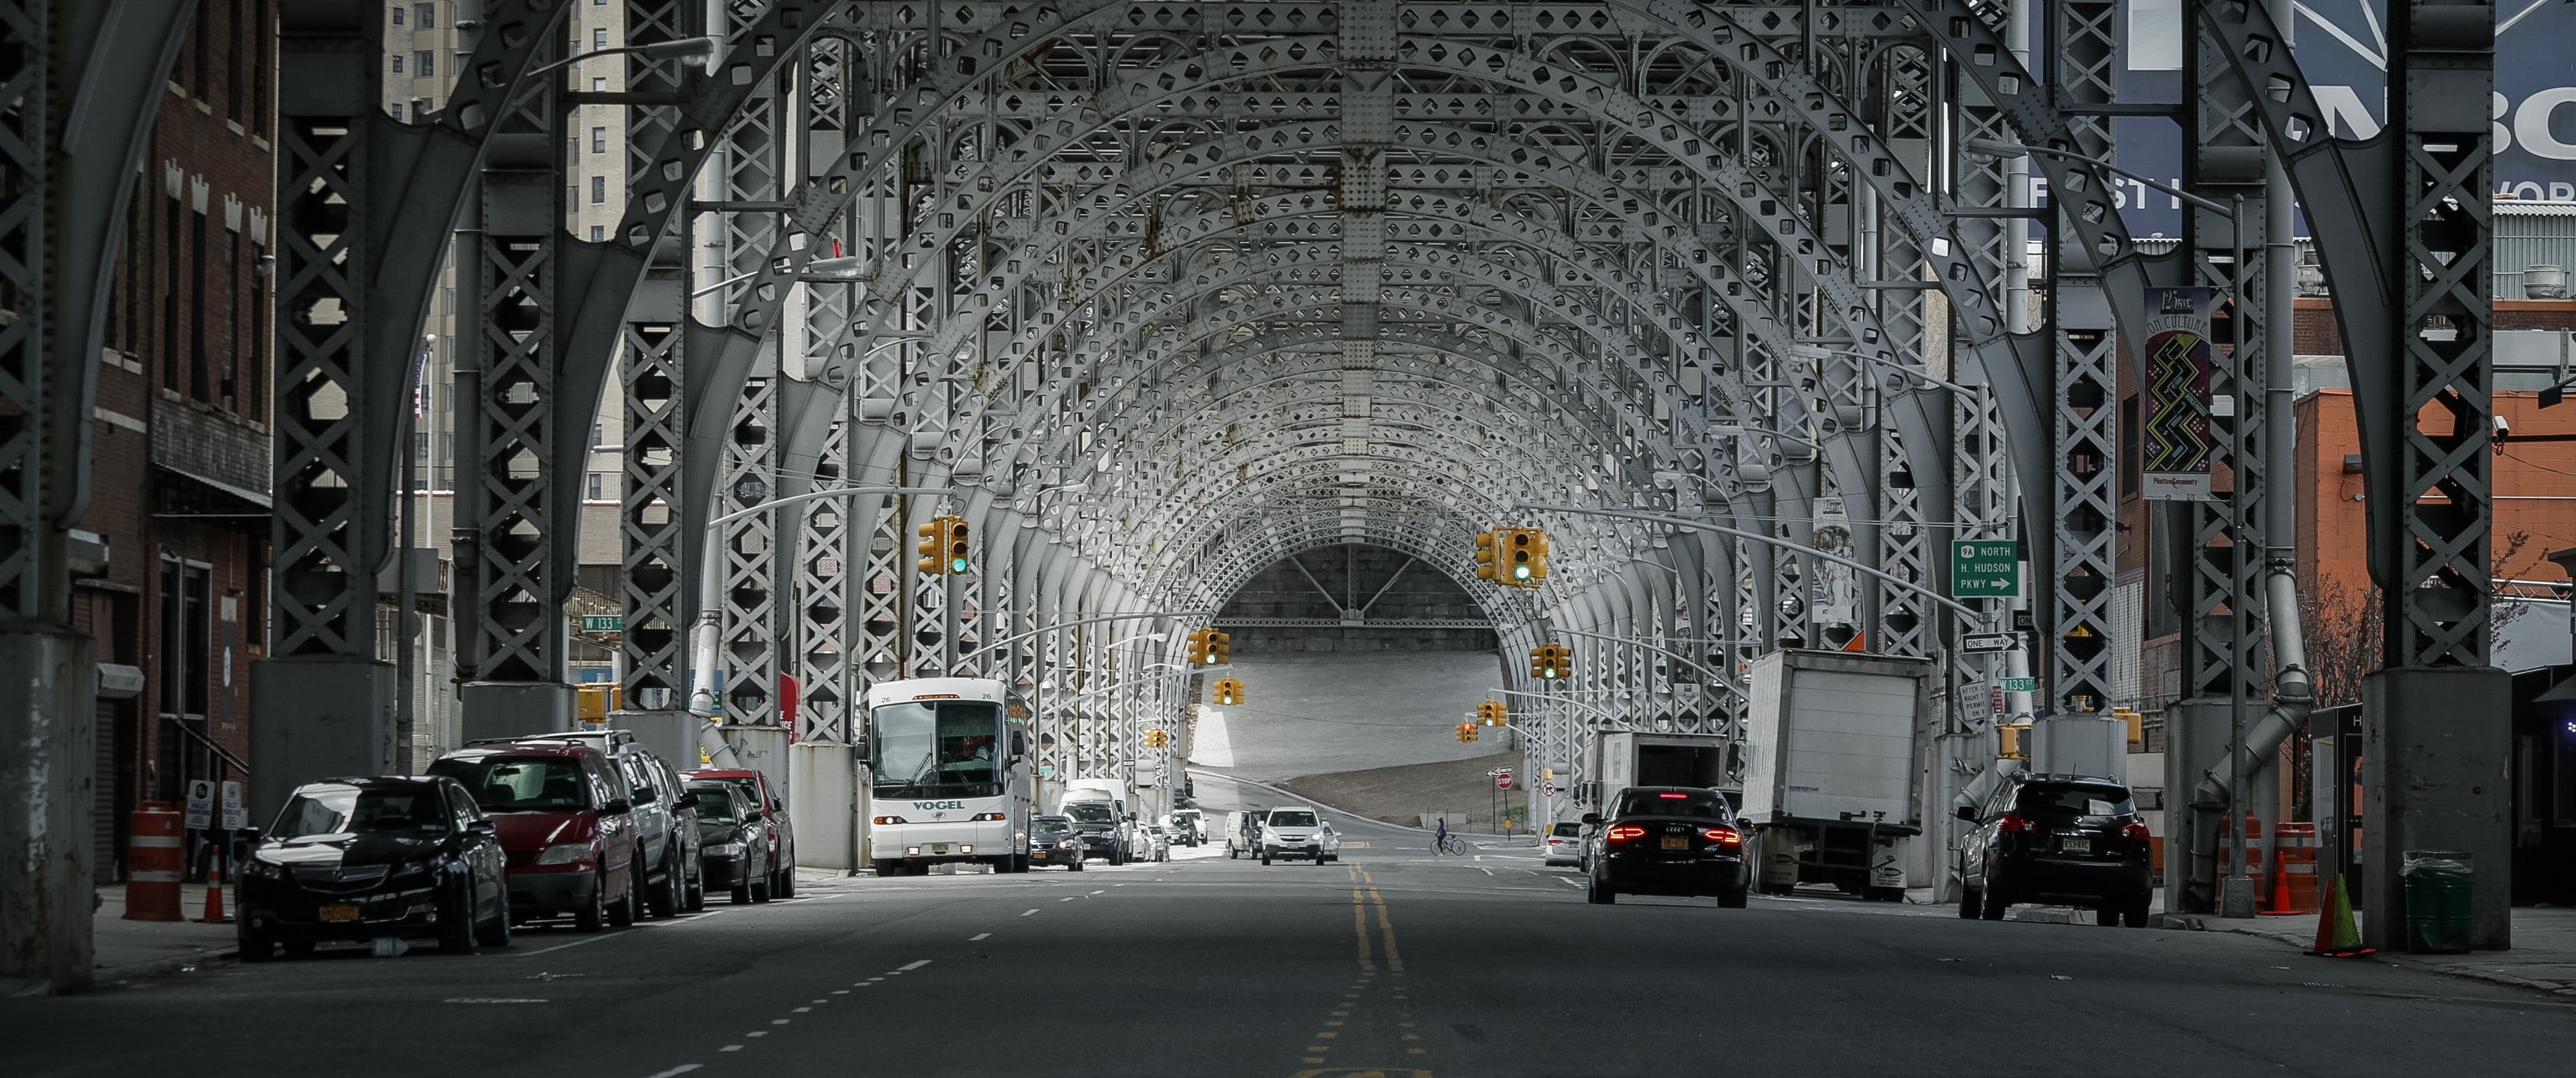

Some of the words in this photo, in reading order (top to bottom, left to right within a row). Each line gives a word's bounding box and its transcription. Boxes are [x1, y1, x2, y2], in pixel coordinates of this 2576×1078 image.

[2165, 315, 2208, 334] CULTURE
[1981, 547, 2011, 556] NORTH
[1961, 564, 1969, 573] H.
[1975, 563, 2011, 573] HUDSON
[1960, 579, 1986, 588] PKWY
[586, 618, 594, 629] W
[599, 618, 613, 629] 133
[1993, 638, 2010, 646] WAY
[2000, 680, 2008, 690] W
[2009, 679, 2025, 690] 133
[913, 801, 965, 810] VOGEL
